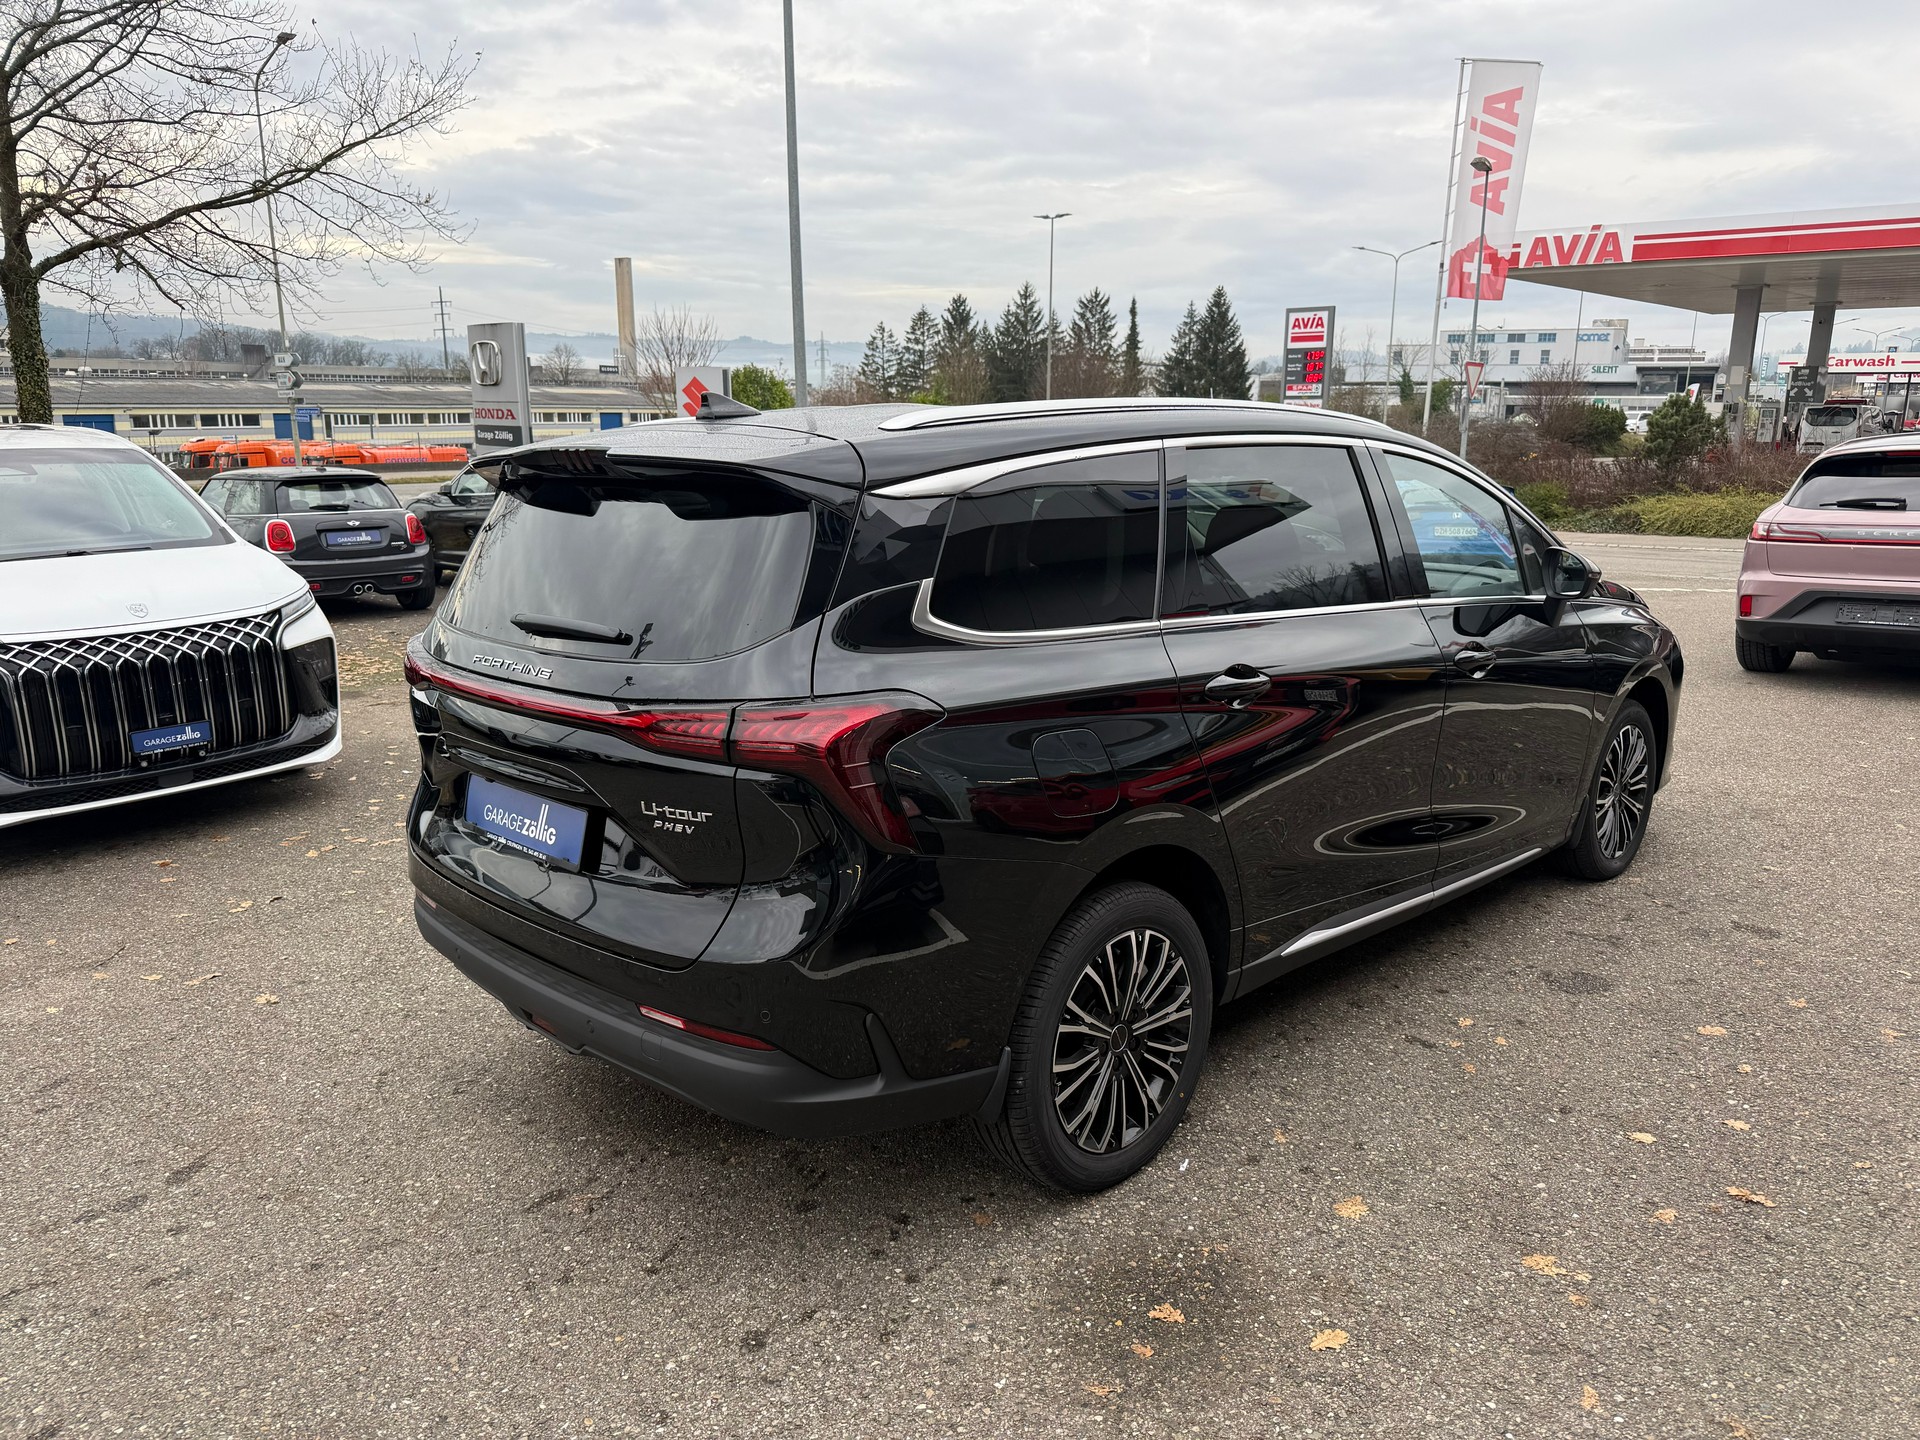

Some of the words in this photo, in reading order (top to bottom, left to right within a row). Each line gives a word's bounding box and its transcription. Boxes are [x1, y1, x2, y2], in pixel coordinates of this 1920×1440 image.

[1524, 224, 1624, 267] AVIA
[1291, 313, 1325, 330] AVIA
[1826, 354, 1896, 367] Carwash
[1591, 365, 1619, 374] SILENT
[474, 407, 517, 420] HONDA
[477, 430, 494, 440] Garage
[494, 430, 513, 442] Zöllig
[472, 654, 554, 680] FORTHING
[640, 800, 713, 823] U-tour
[653, 820, 695, 835] PHEV
